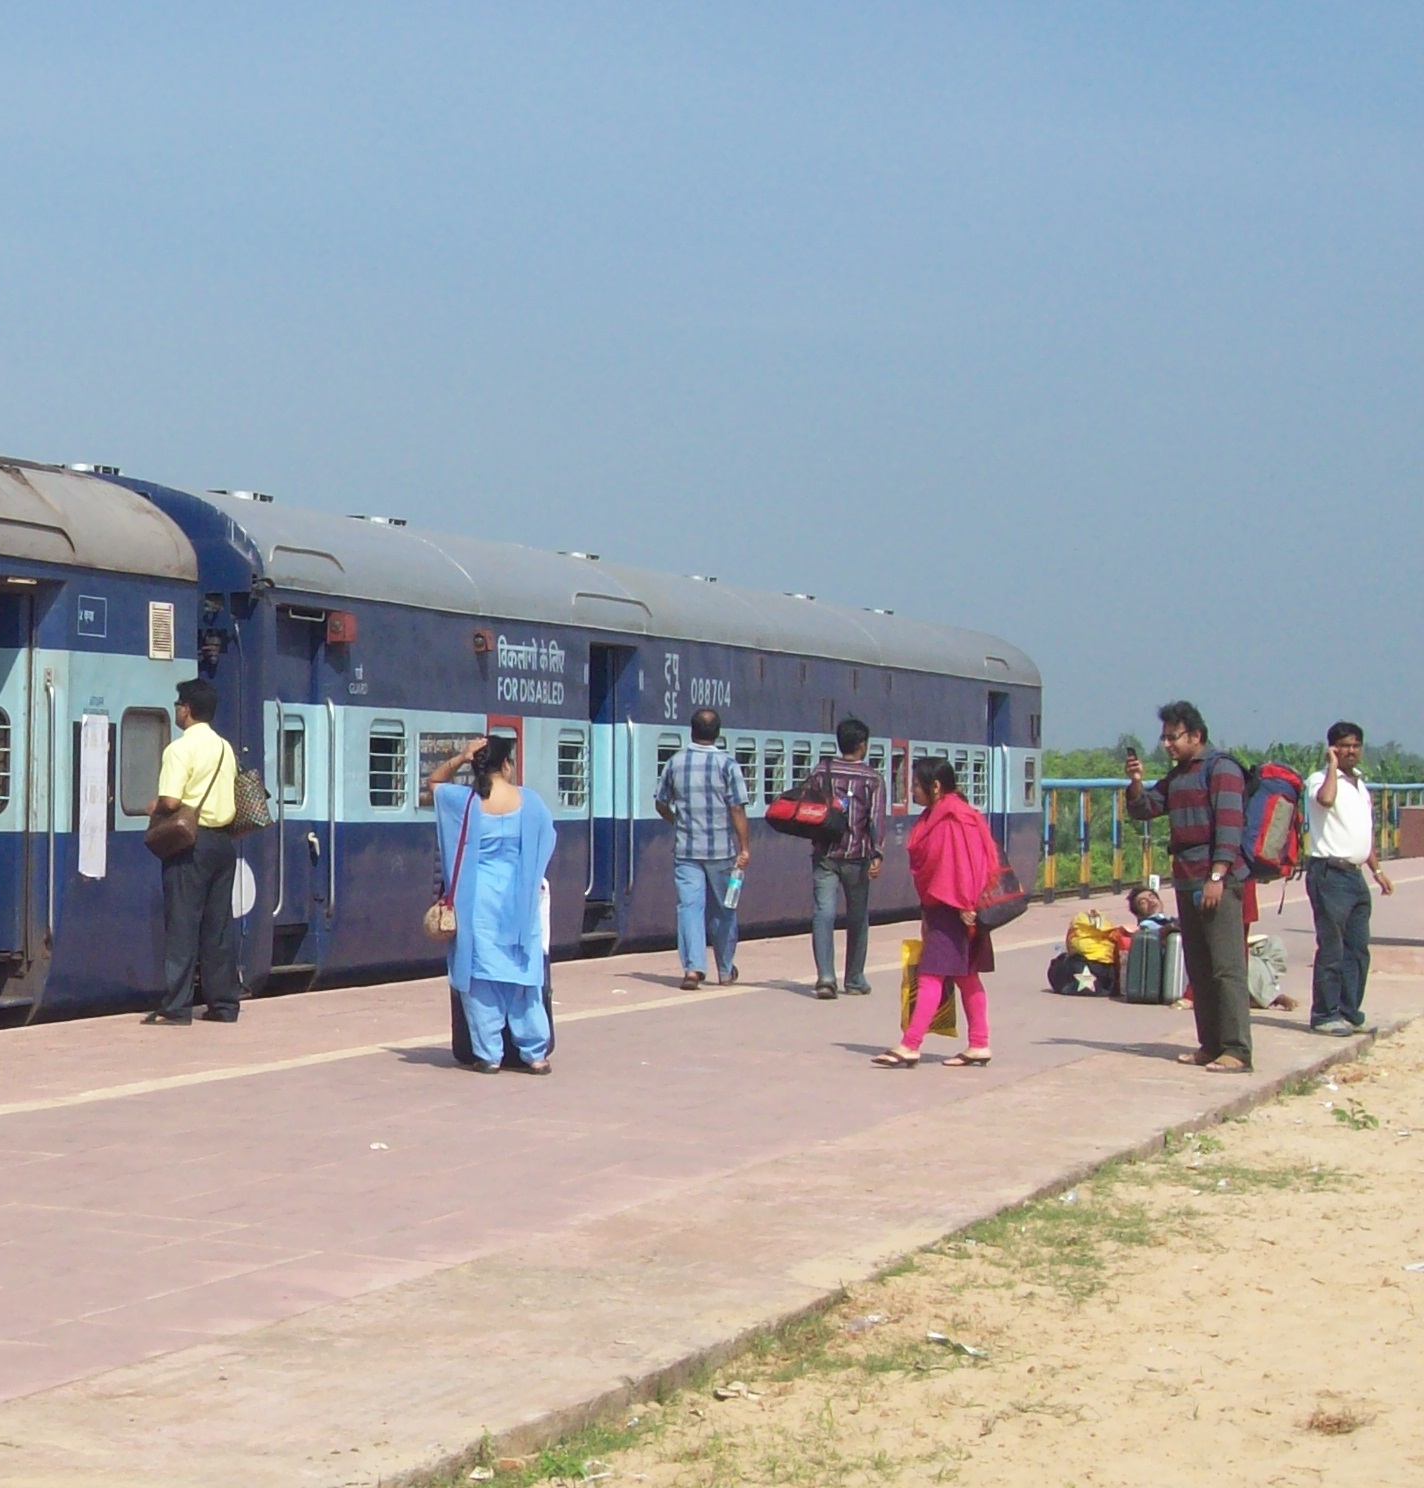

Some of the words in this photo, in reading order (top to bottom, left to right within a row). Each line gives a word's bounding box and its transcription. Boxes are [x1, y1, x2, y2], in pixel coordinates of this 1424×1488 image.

[497, 676, 519, 702] FOR
[520, 678, 565, 706] DISABLED
[690, 677, 731, 708] 088704
